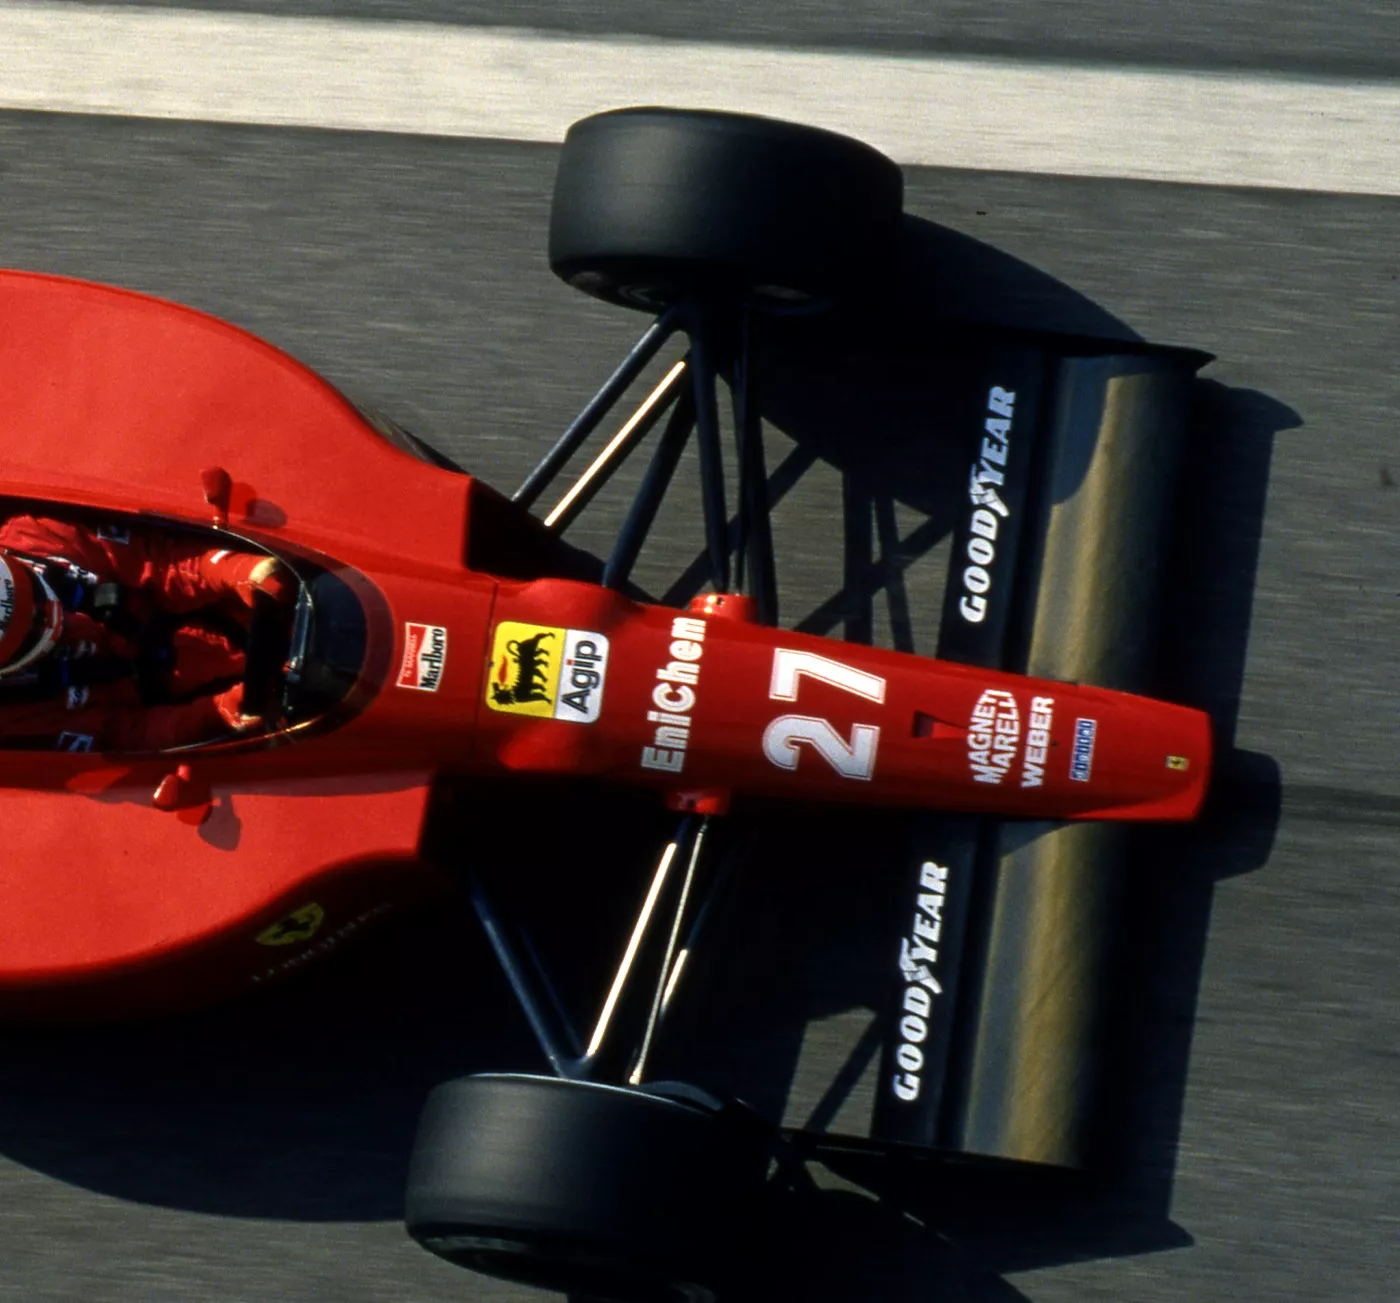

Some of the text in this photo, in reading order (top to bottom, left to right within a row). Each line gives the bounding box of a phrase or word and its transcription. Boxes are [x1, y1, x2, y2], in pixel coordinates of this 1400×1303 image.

[960, 386, 1016, 622] GOODYEAR
[420, 629, 443, 689] Marlboro
[561, 640, 602, 714] Agip
[641, 617, 706, 772] EniChem
[762, 647, 887, 781] 27
[967, 689, 998, 783] MAGNETI
[987, 690, 1020, 784] MARELLI
[1021, 696, 1055, 787] WEBER
[893, 861, 949, 1100] GOODYEAR
